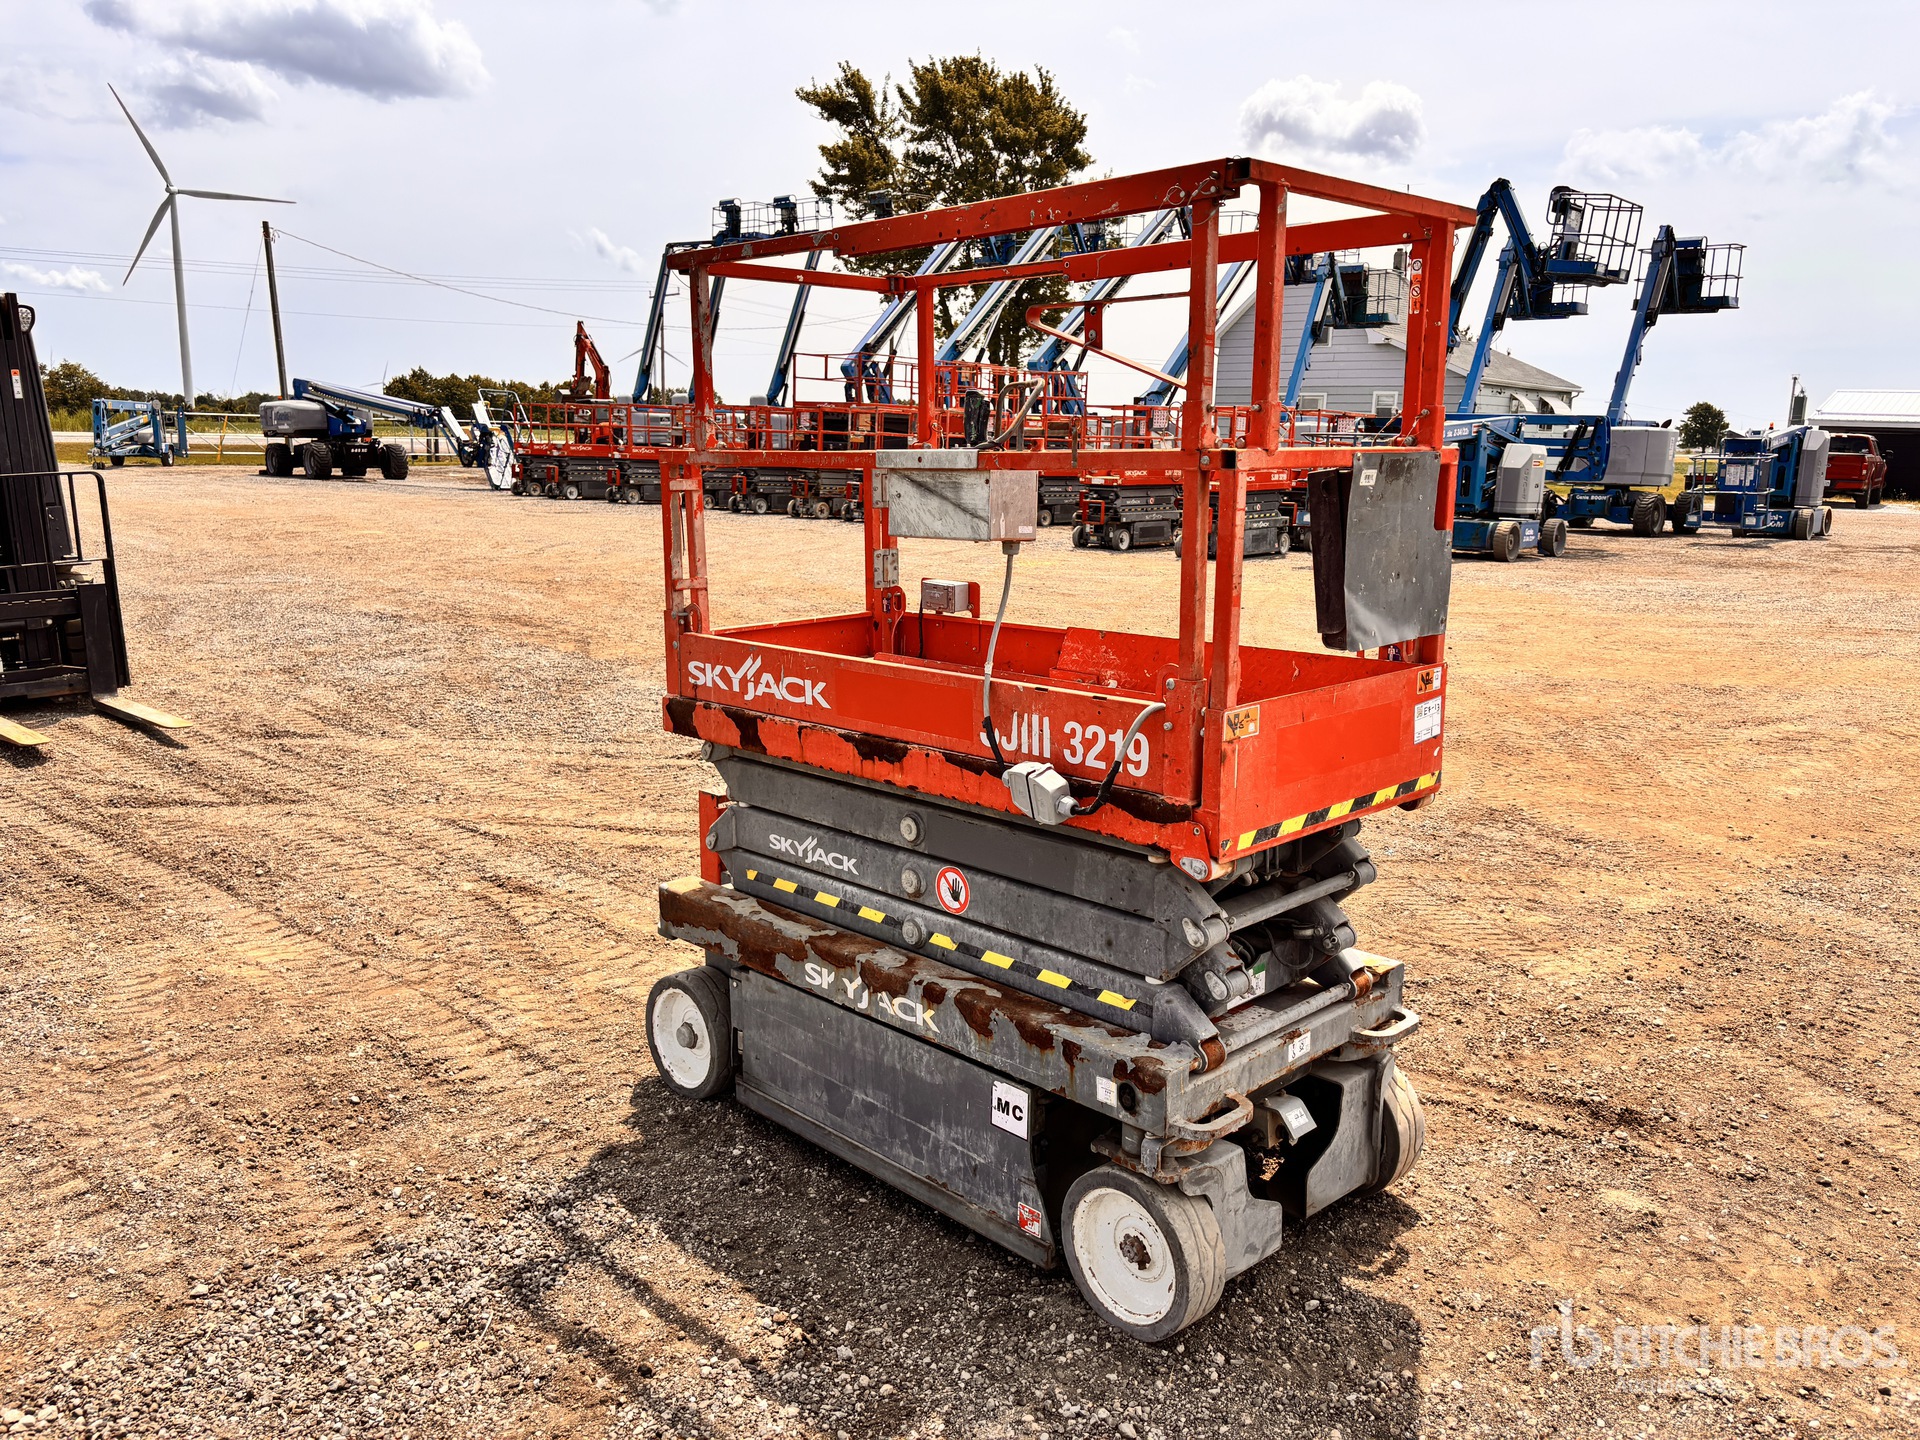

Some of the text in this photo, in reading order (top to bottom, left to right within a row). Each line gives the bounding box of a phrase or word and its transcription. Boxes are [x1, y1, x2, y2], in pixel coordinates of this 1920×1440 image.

[1124, 469, 1148, 477] SKYJACK
[687, 654, 832, 709] SKYJACK
[1063, 720, 1150, 778] 3219
[769, 835, 860, 876] SKYJACK
